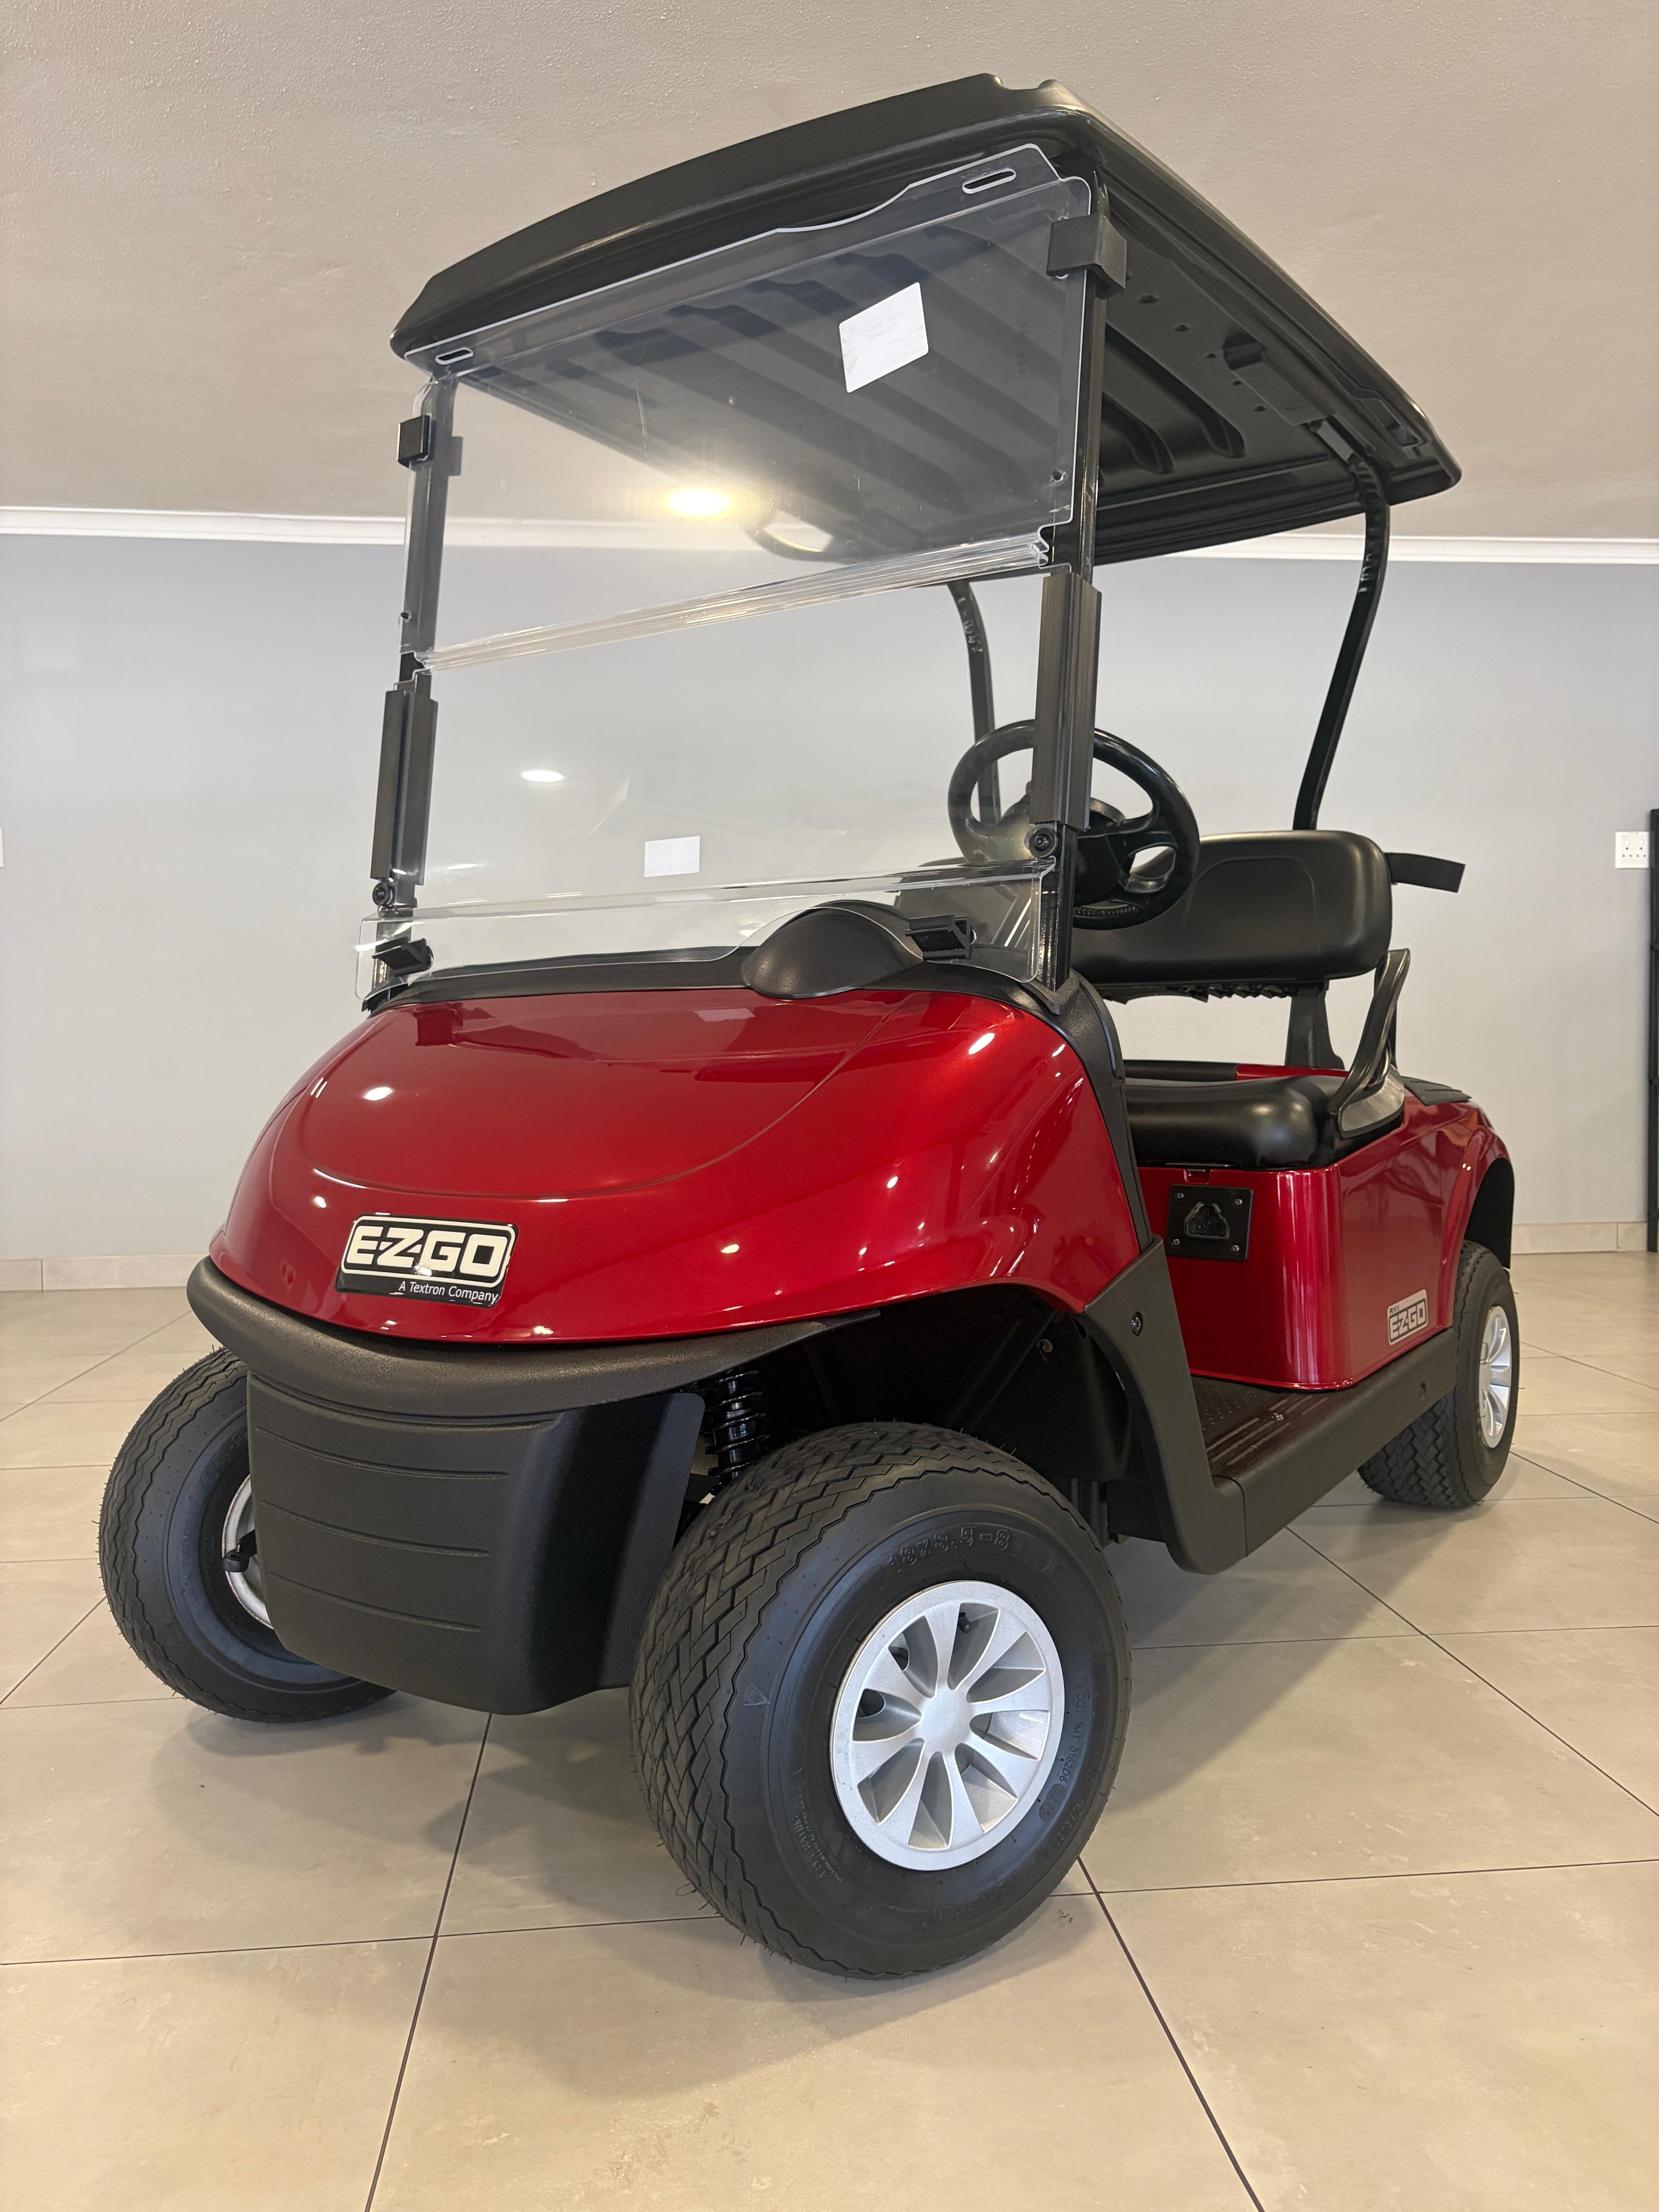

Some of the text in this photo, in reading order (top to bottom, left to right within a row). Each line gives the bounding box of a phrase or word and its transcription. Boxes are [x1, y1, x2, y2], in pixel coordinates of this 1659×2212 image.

[398, 1281, 499, 1304] A Textron Company
[1389, 1305, 1400, 1314] RXV
